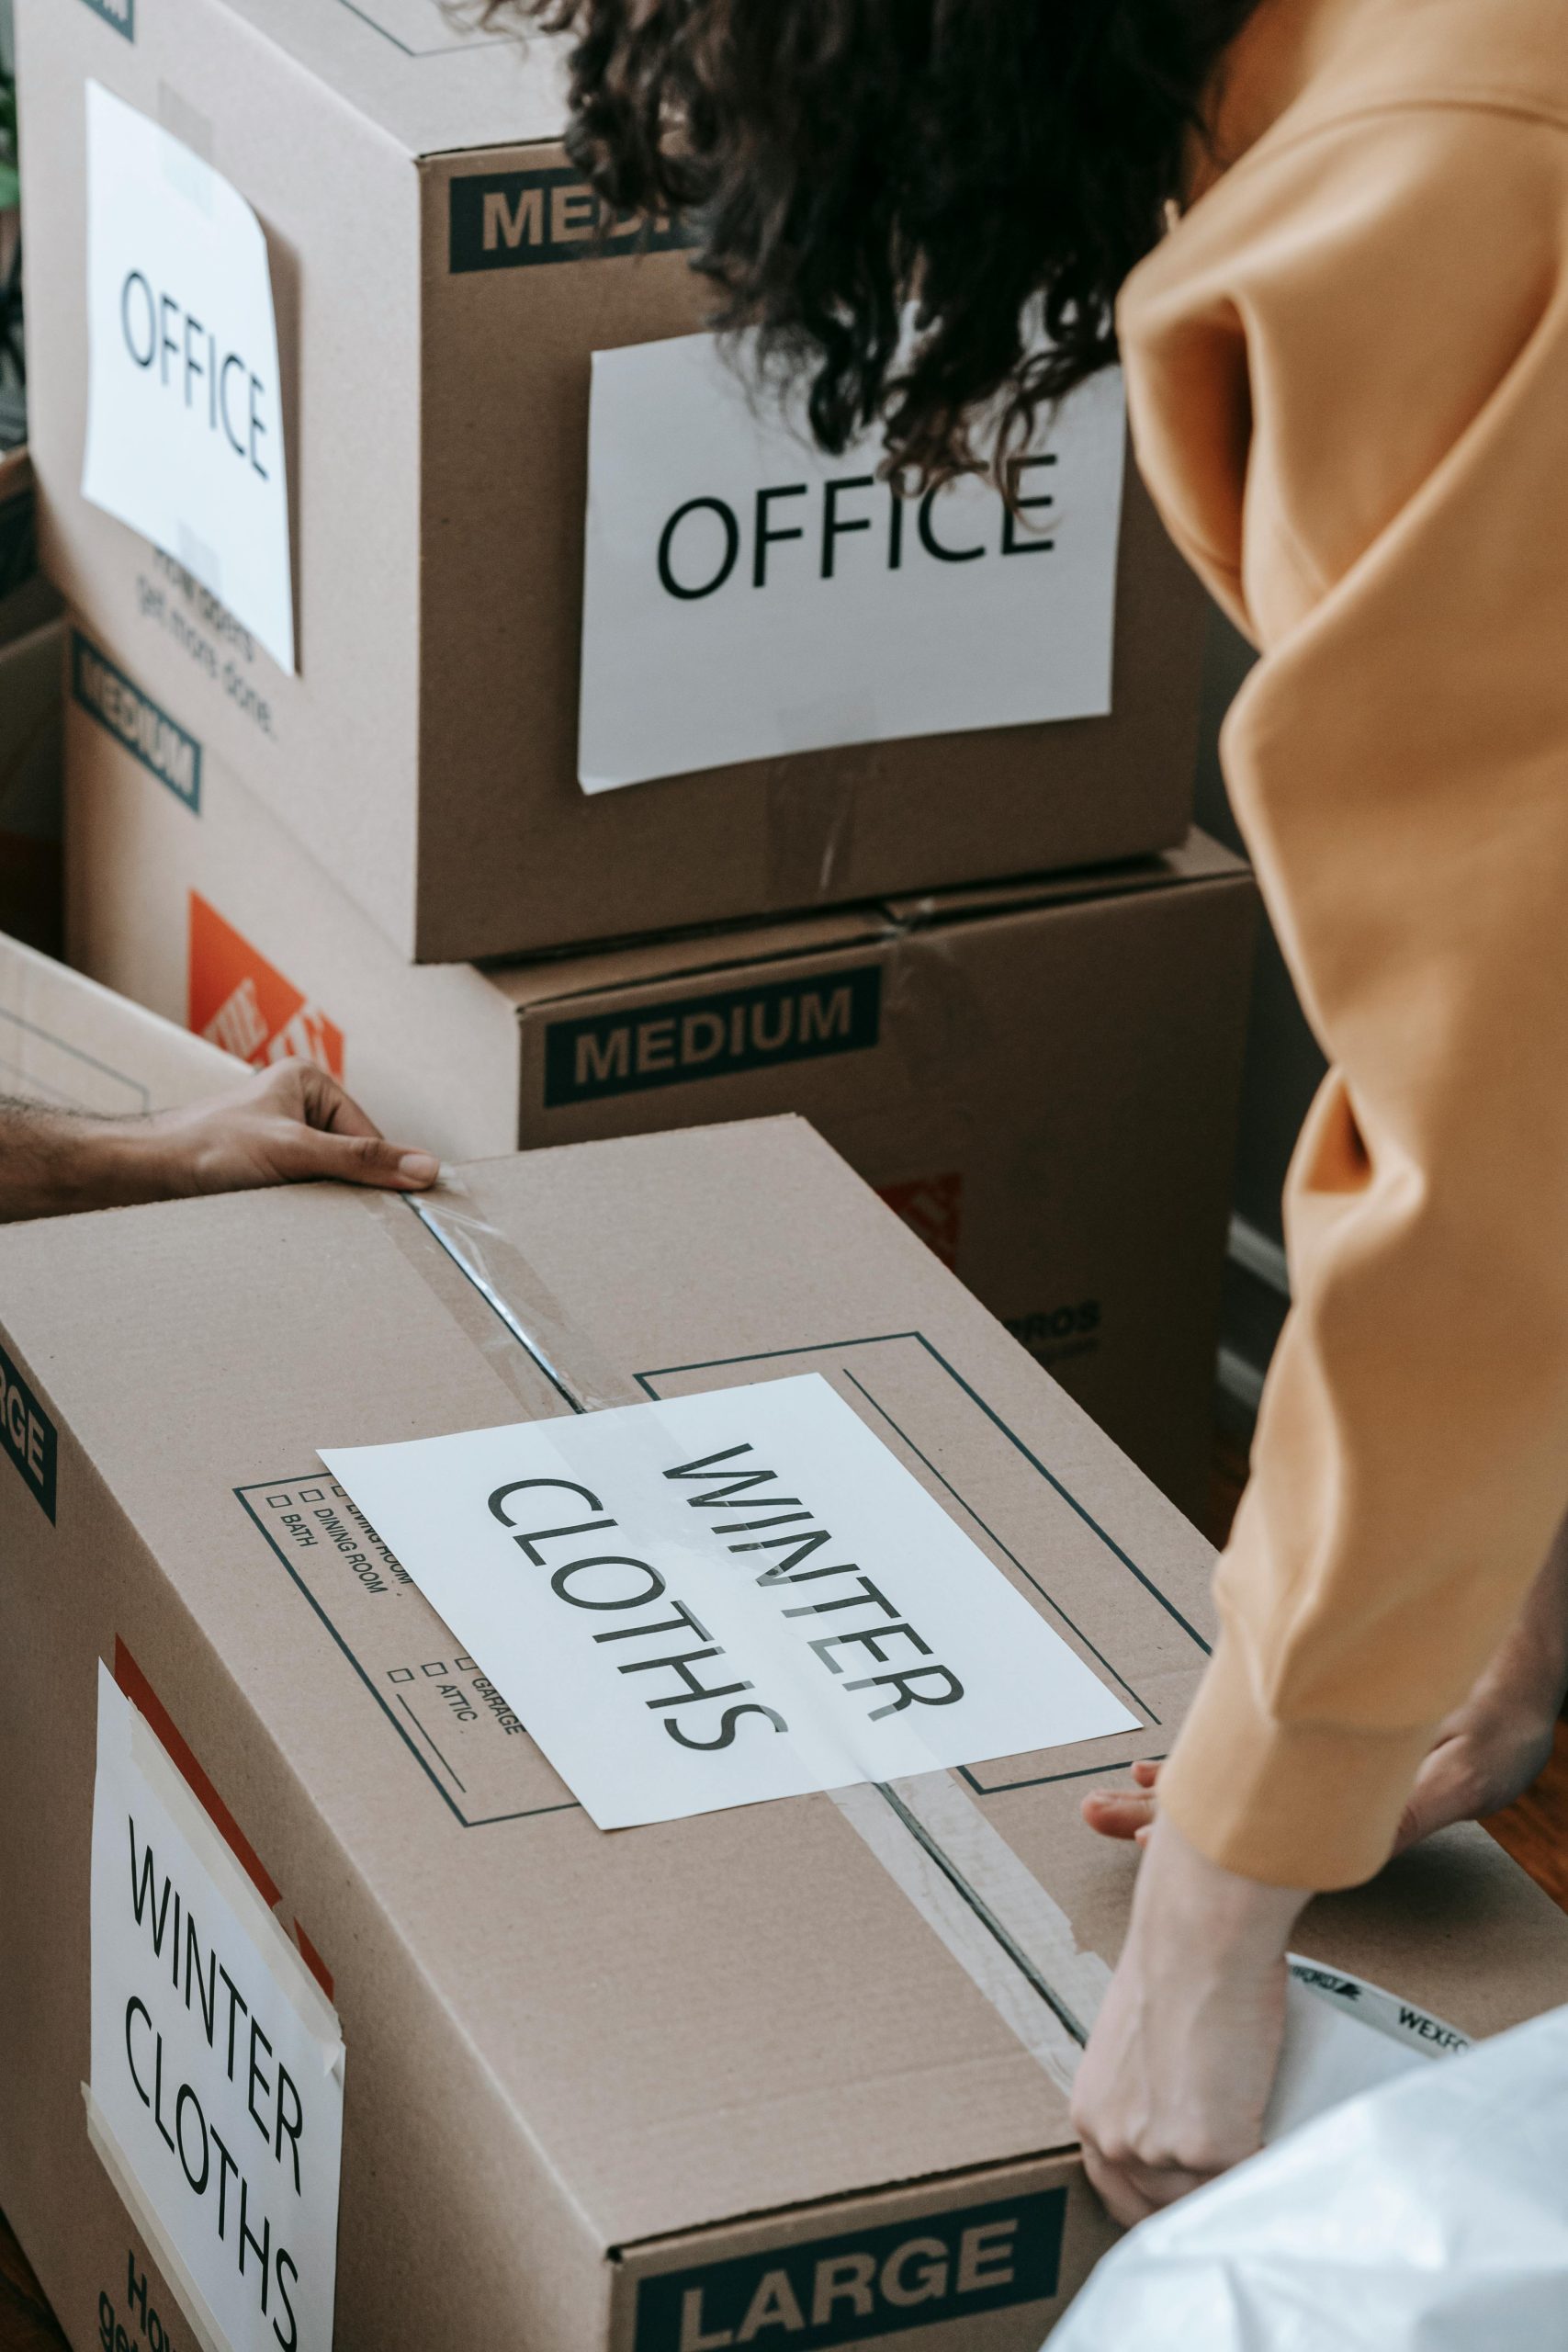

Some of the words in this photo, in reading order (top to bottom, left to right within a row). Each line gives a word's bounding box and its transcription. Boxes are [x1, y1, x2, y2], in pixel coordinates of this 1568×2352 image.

[120, 269, 269, 481] OFFICE
[657, 454, 1057, 601] OFFICE
[82, 648, 194, 797] MEDIUM
[574, 986, 852, 1086] MEDIUM
[280, 1513, 319, 1547] BATH
[313, 1508, 357, 1553] DINING
[344, 1554, 389, 1593] ROOM
[661, 1442, 964, 1722] WINTER
[488, 1477, 787, 1750] CLOTHS
[435, 1684, 478, 1722] ATTIC
[471, 1678, 526, 1735] GARAGE
[129, 1814, 304, 2197] WINTER
[125, 1996, 299, 2351] CLOTHS
[680, 2218, 1019, 2352] LARGE
